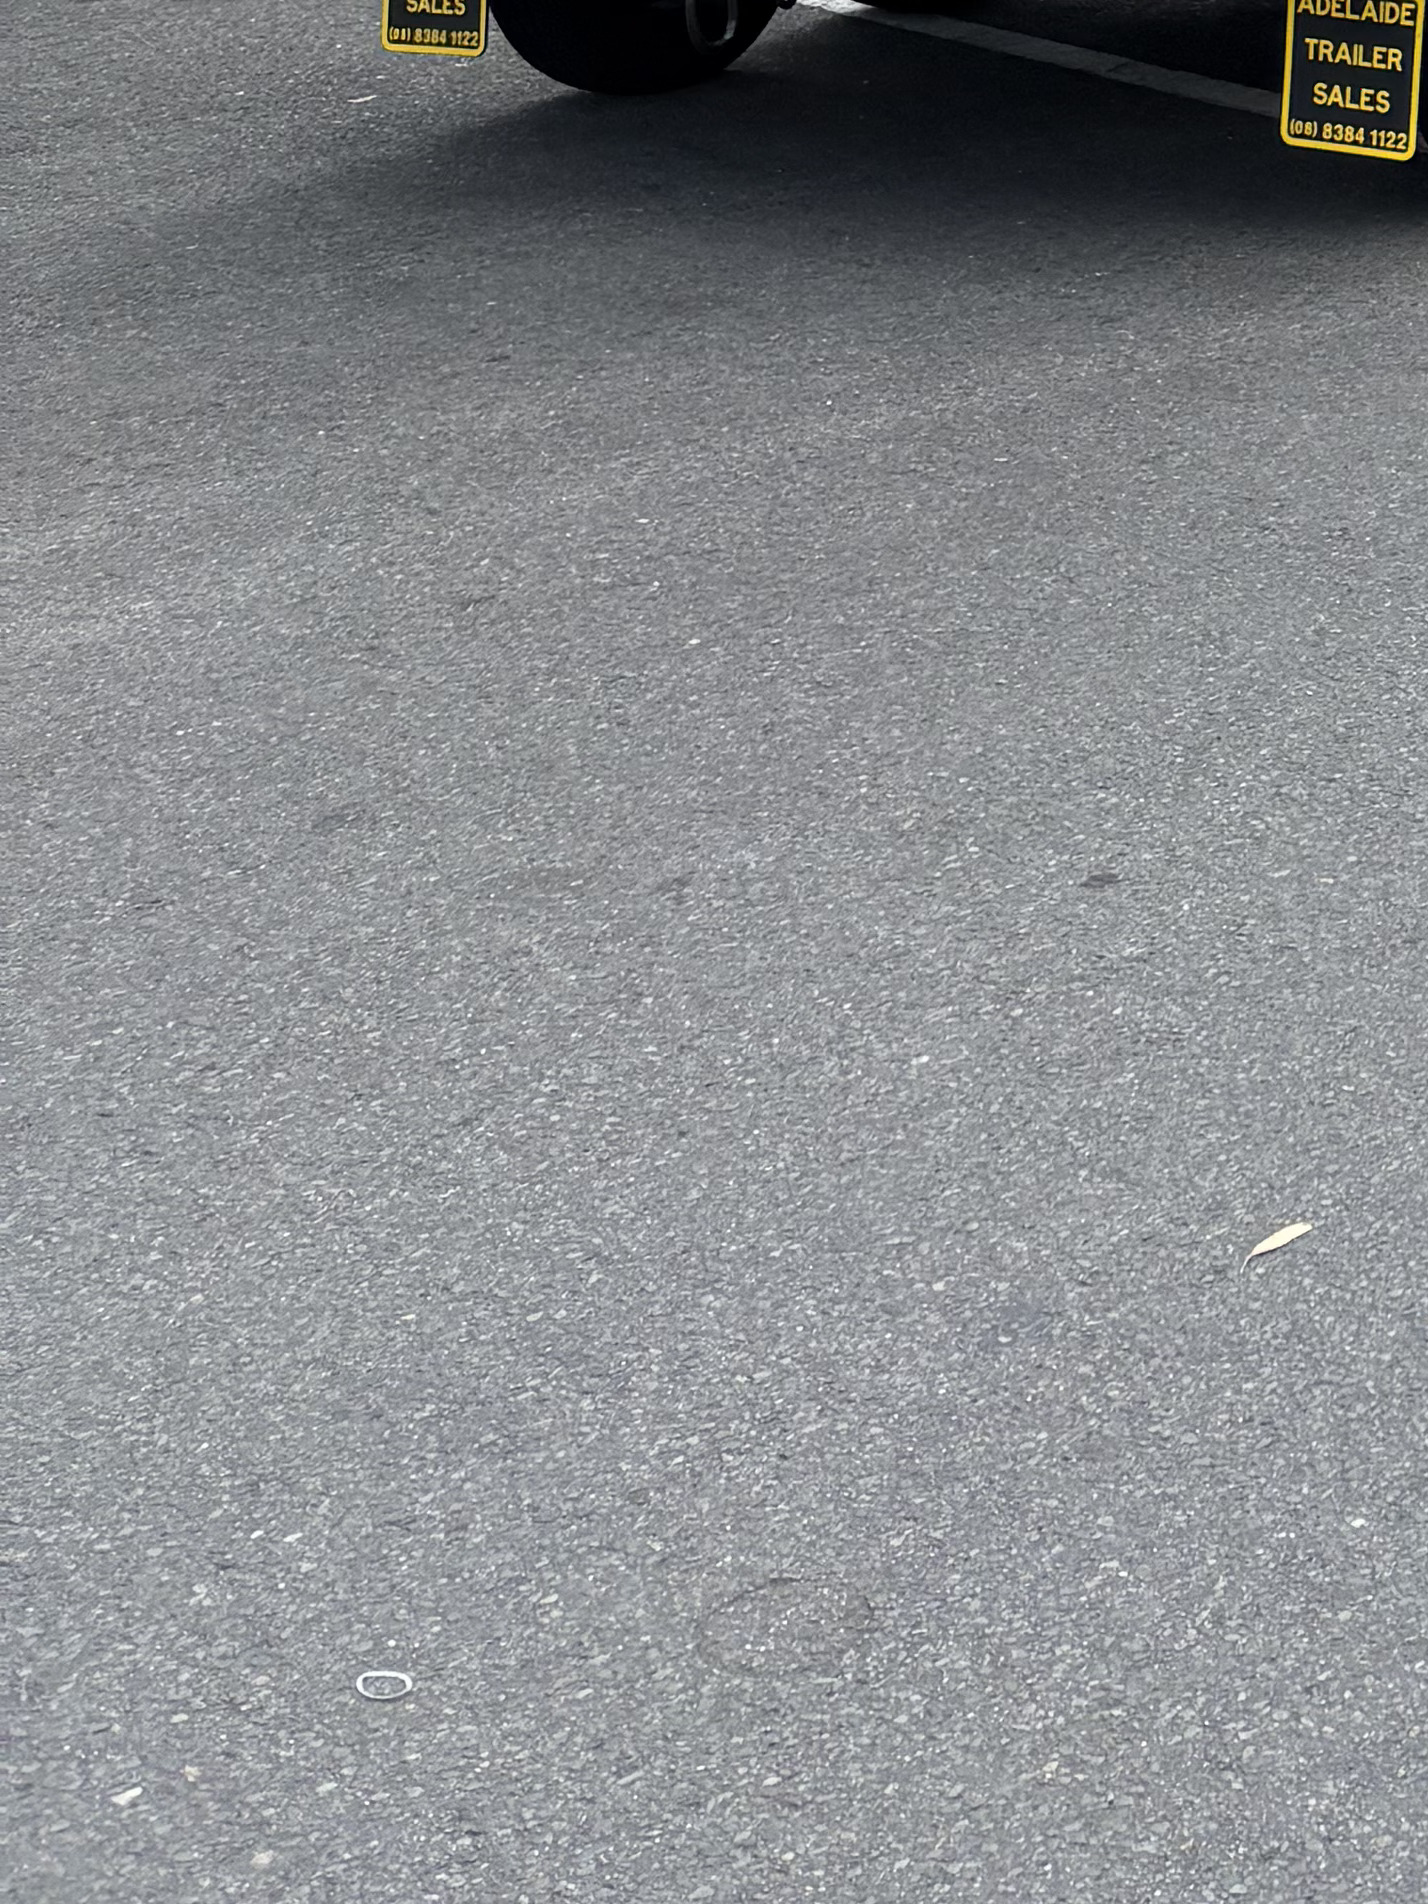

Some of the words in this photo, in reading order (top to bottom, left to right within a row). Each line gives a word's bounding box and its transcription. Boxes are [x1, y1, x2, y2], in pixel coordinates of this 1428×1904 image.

[1304, 37, 1403, 72] TRAILER
[1313, 82, 1391, 114] SALES
[1289, 118, 1318, 138] (08)
[1322, 122, 1365, 145] 8384
[1369, 129, 1408, 151] 1122
